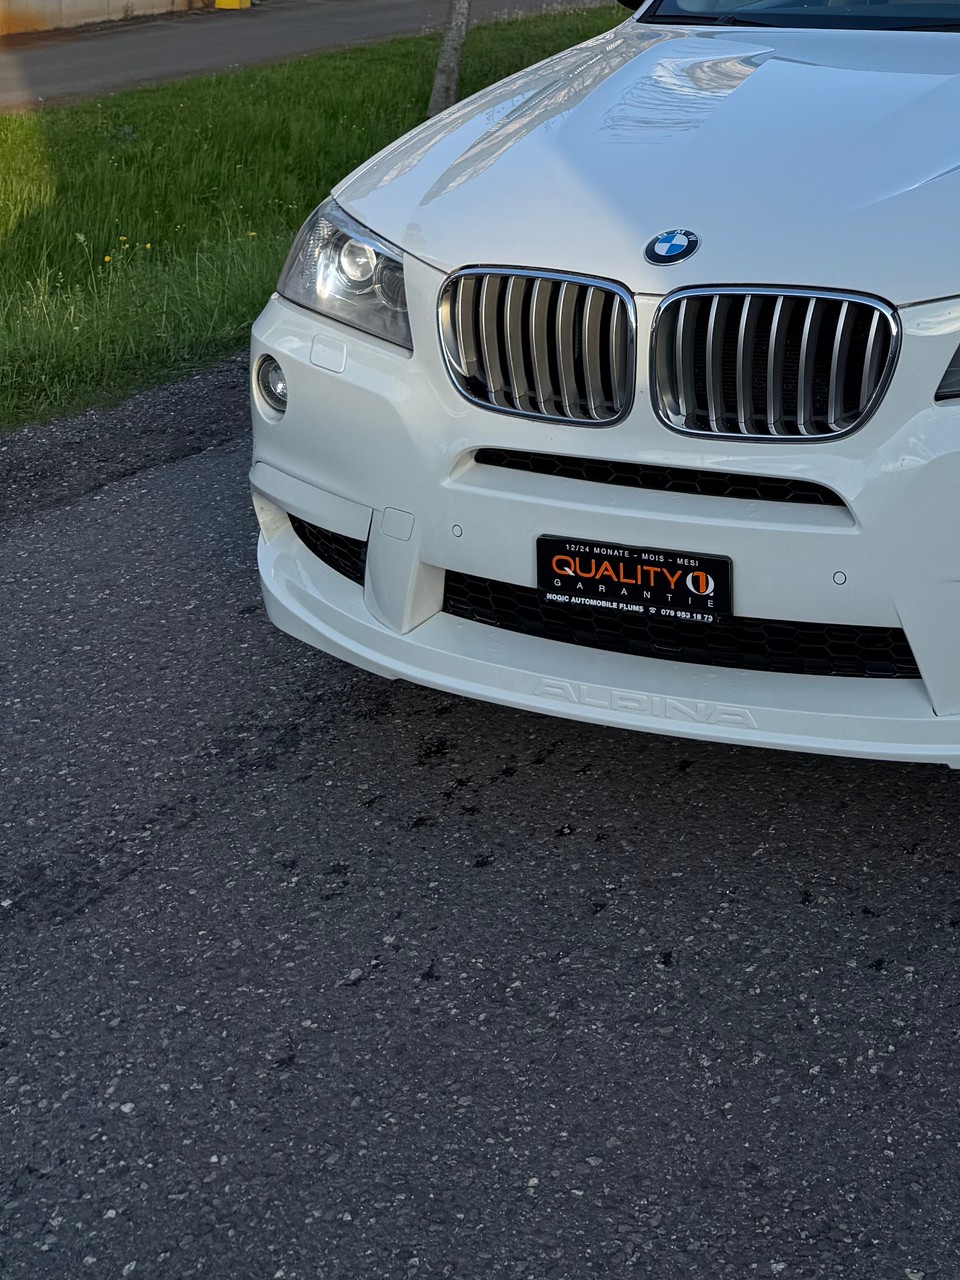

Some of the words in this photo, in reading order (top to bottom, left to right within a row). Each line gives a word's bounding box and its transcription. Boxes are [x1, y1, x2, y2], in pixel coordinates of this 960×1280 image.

[565, 544, 590, 553] 12/24
[593, 547, 630, 558] MONATE
[641, 553, 665, 562] MOIS
[676, 557, 699, 567] MESI
[551, 554, 683, 590] QUALITY
[553, 578, 714, 608] GARANTIE
[570, 596, 618, 609] AUTOMOBILE
[619, 602, 644, 613] FLUMS
[660, 608, 675, 617] 079
[531, 676, 759, 730] ALPINA
